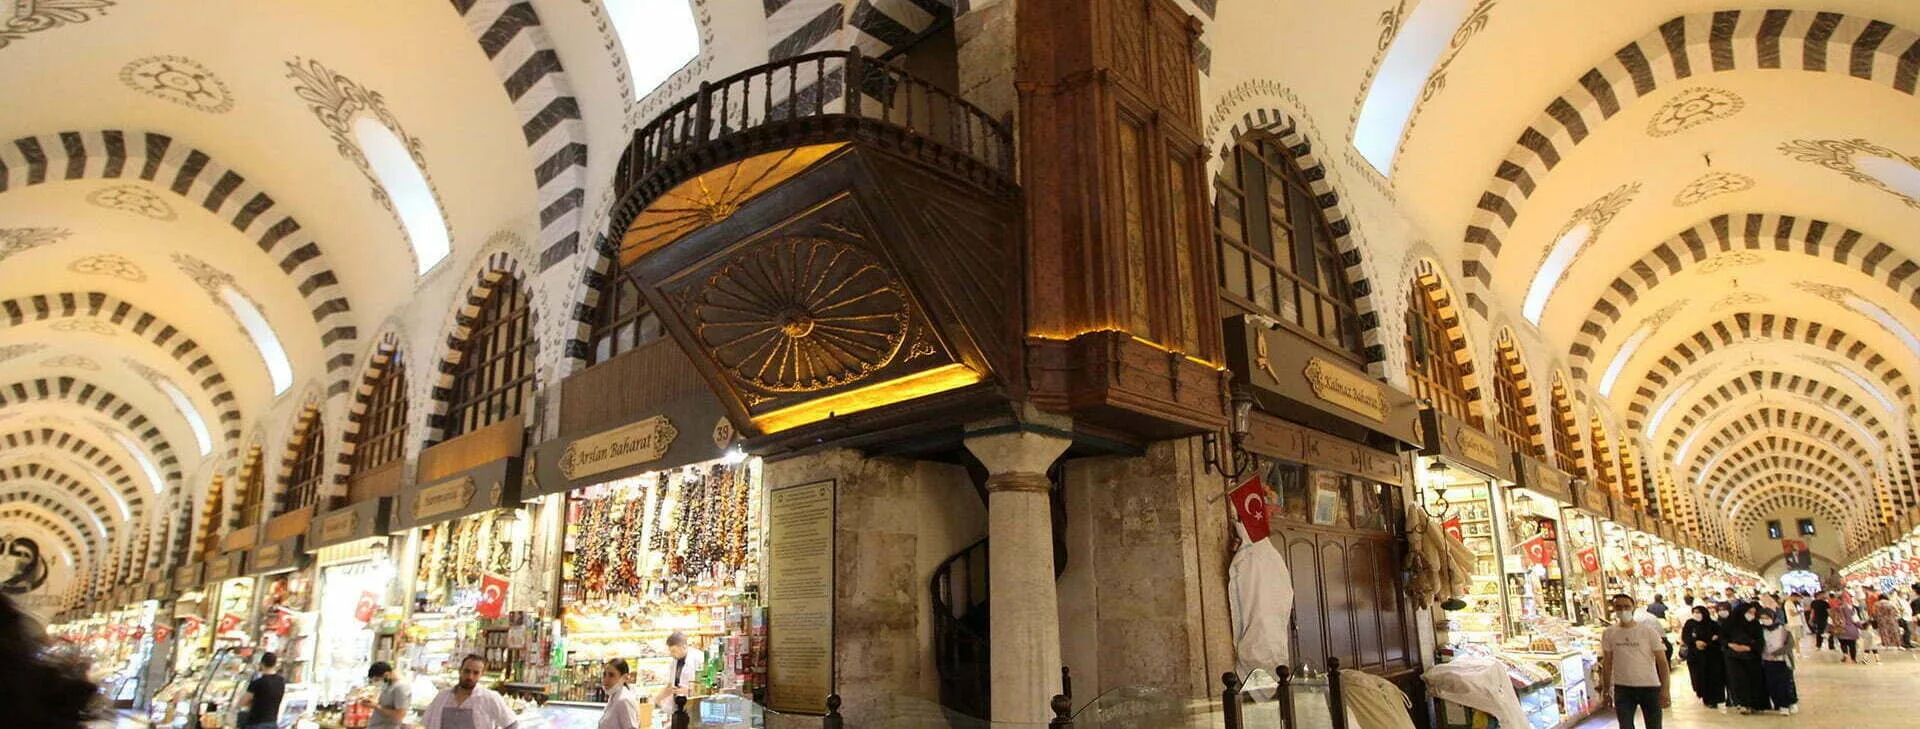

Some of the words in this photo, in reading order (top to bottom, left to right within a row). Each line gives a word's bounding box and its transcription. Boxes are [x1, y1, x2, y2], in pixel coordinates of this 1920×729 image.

[716, 425, 729, 441] 39
[576, 445, 608, 465] Arslan
[610, 434, 651, 458] Baharat
